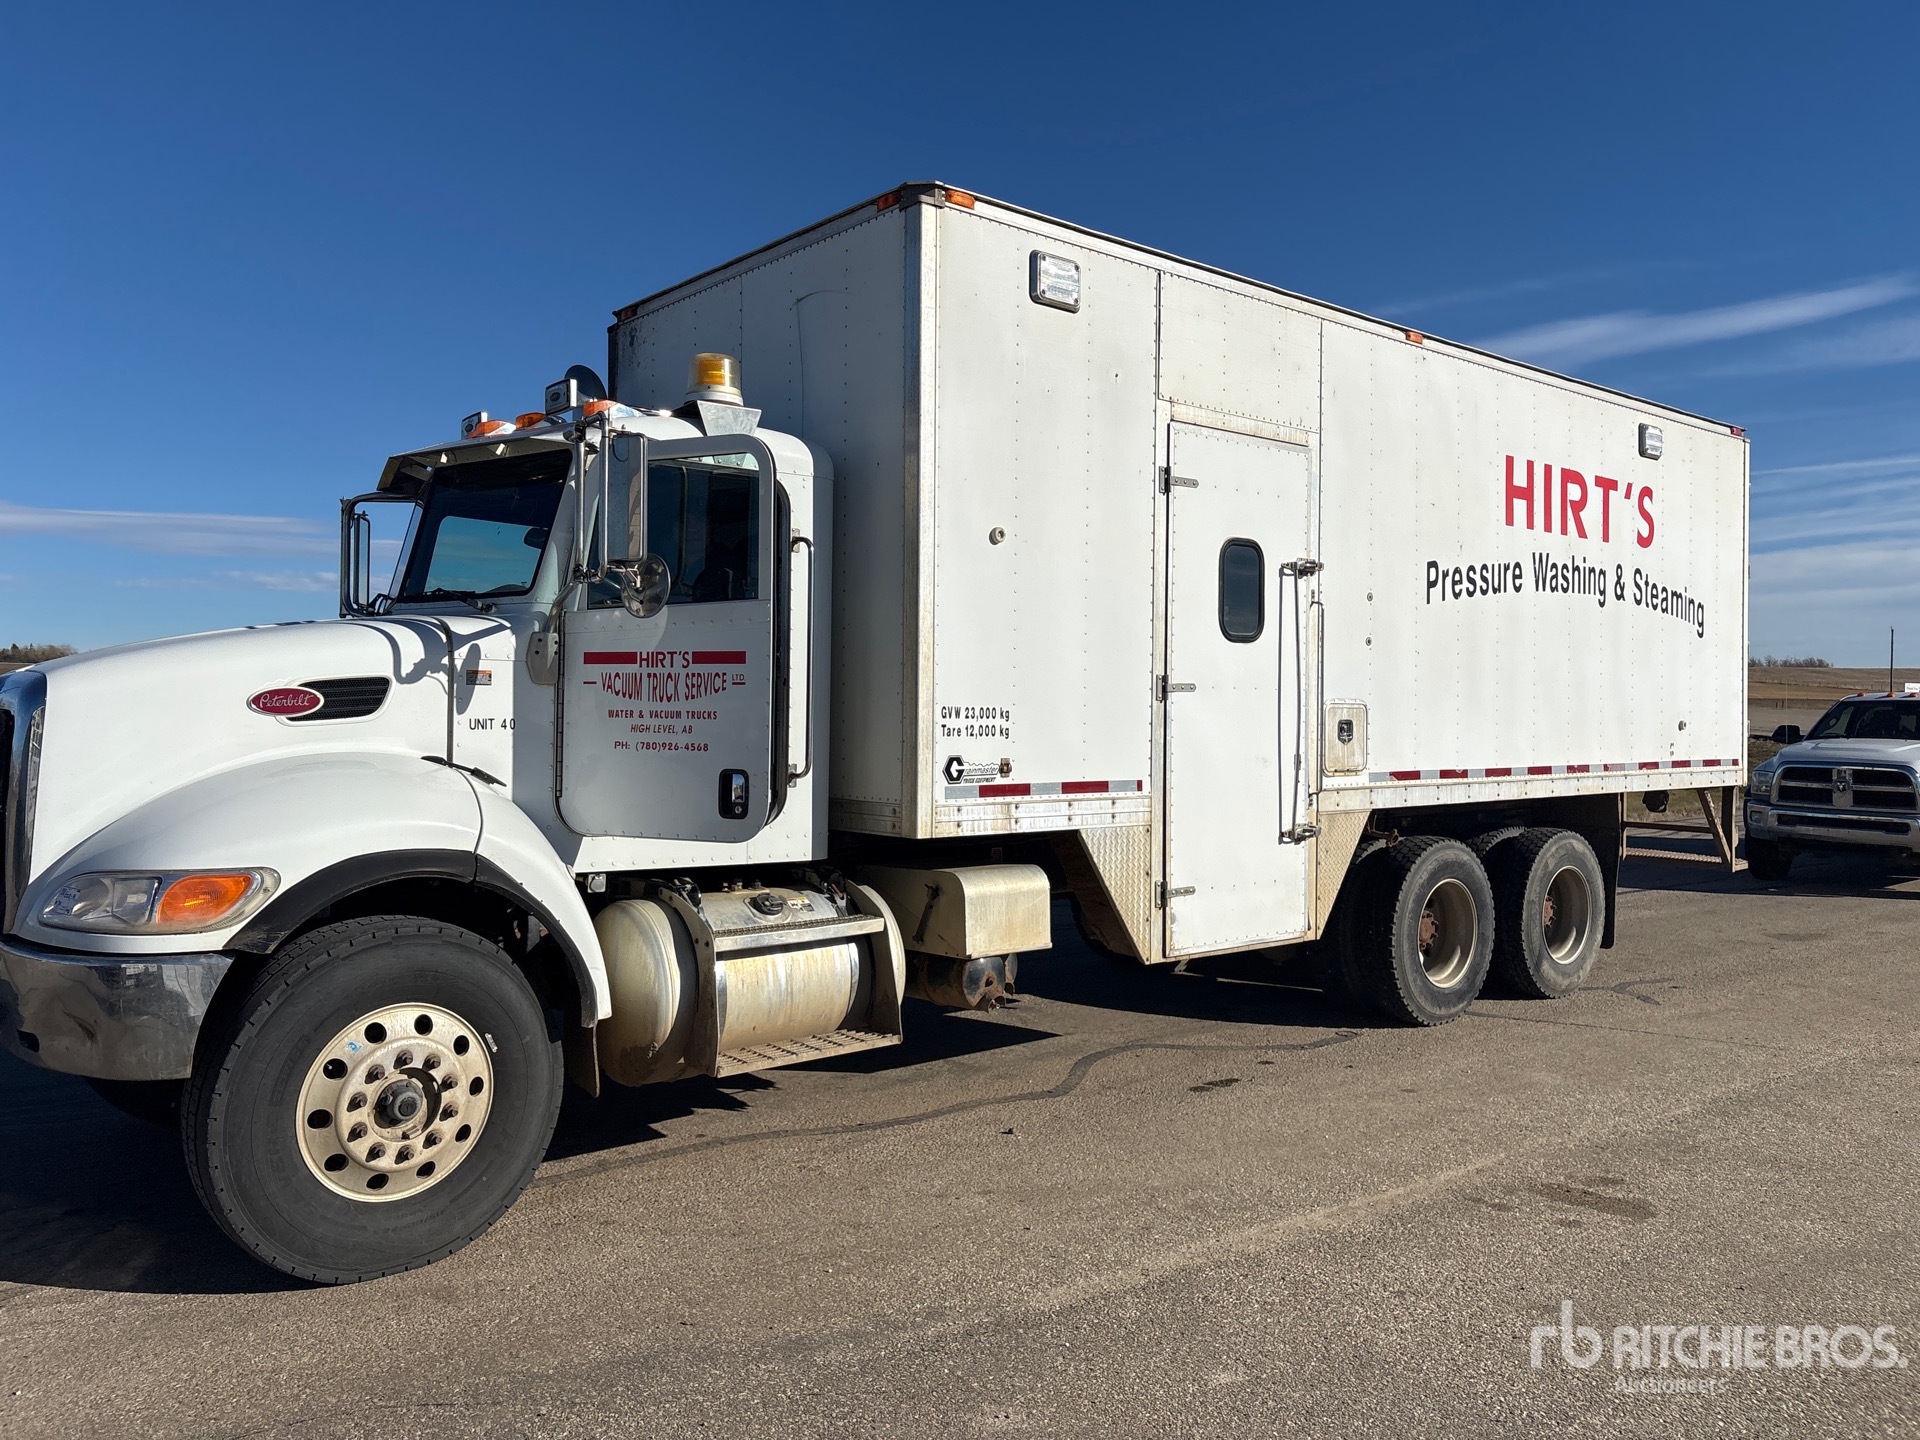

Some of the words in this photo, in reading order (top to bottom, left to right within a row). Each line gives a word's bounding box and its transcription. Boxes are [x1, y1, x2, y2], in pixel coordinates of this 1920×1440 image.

[1505, 454, 1655, 549] HIRT'S
[1426, 559, 1524, 605] Pressure
[1532, 551, 1607, 608] Washing
[1614, 563, 1626, 602] &
[1633, 567, 1705, 639] Steaming
[638, 651, 691, 669] HIRT'S
[601, 672, 643, 701] VACUUM
[647, 671, 681, 703] TRUCK
[684, 671, 728, 701] SERVICE
[259, 693, 314, 708] Peterbilt
[608, 710, 634, 718] WATER
[638, 709, 645, 719] &
[649, 710, 681, 719] VACUUM
[686, 710, 718, 720] TRUCKS
[941, 706, 961, 719] GVW
[964, 707, 996, 722] 23,000
[999, 707, 1010, 722] kg
[469, 718, 495, 730] UNIT
[630, 724, 650, 733] HIGH
[653, 723, 679, 736] LEVEL,
[681, 723, 693, 734] AB
[941, 724, 962, 737] Tare
[965, 724, 996, 739] 12,000
[999, 724, 1010, 739] kg
[614, 741, 630, 749] PH:
[635, 741, 709, 752] (780)926-4568
